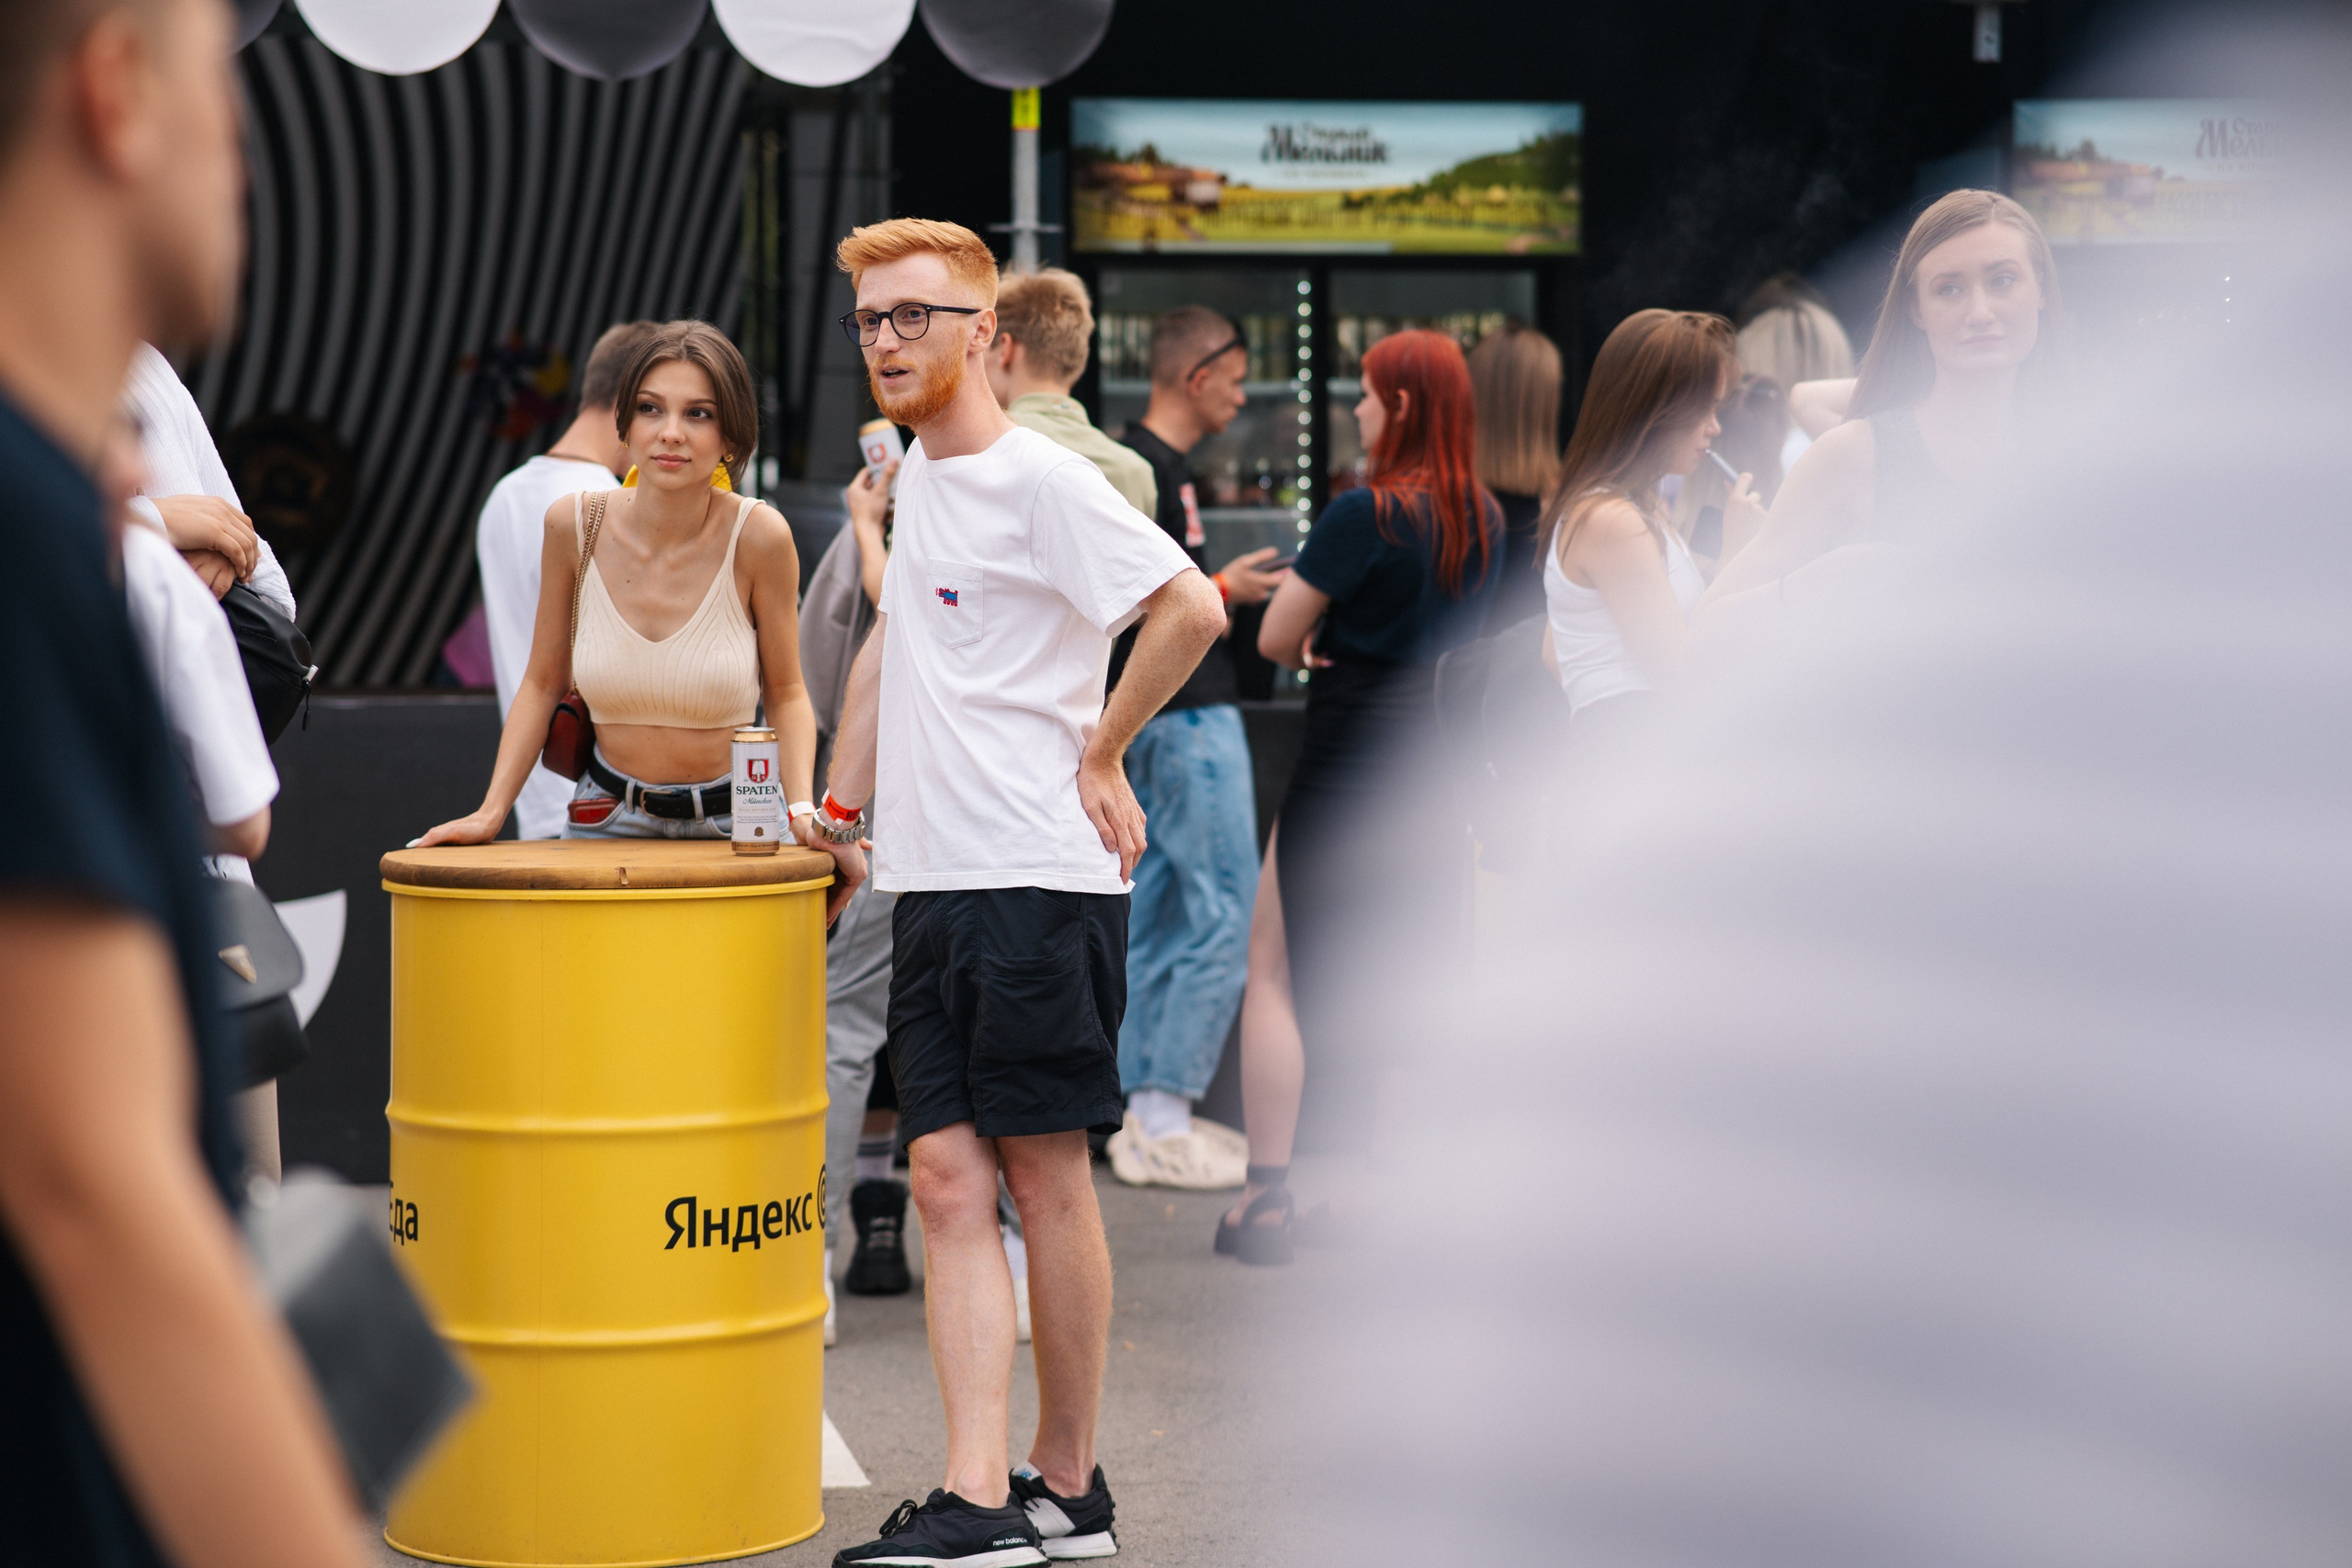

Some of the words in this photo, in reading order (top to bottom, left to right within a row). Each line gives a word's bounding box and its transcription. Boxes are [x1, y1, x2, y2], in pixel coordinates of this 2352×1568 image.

[736, 784, 777, 795] SPATEN
[742, 796, 773, 805] München
[663, 1192, 813, 1253] Яндекс
[992, 1539, 1004, 1547] new
